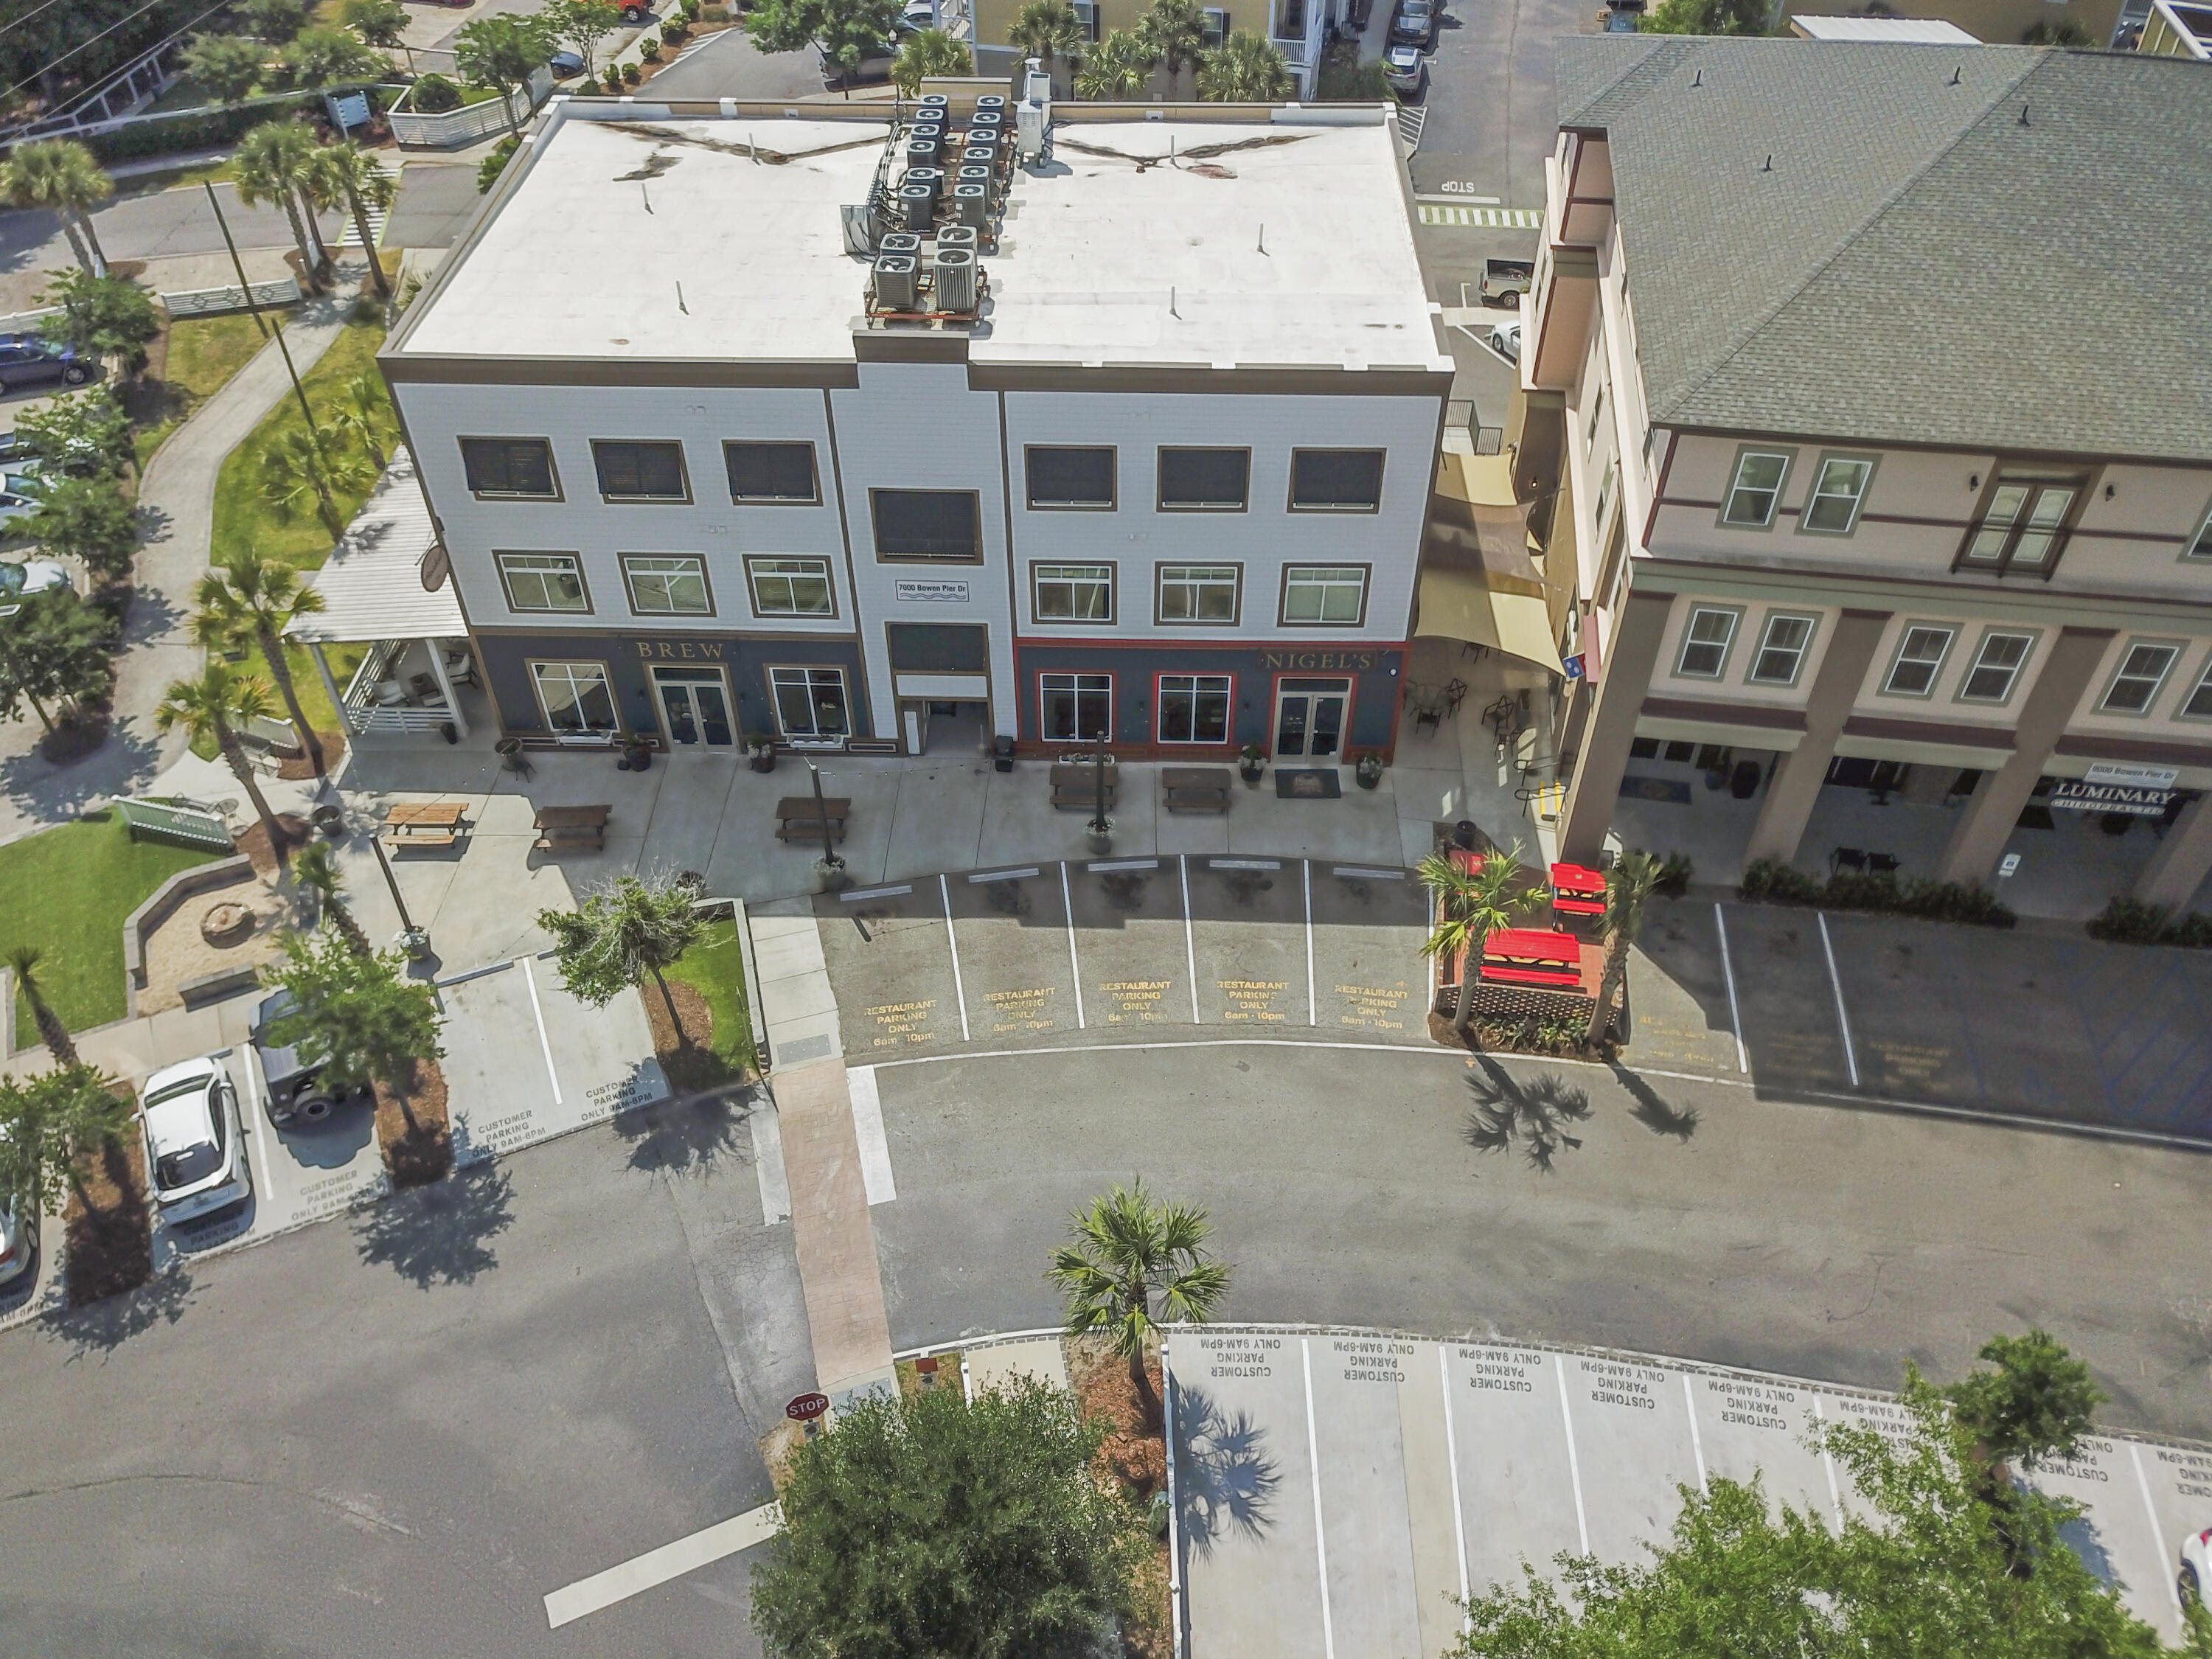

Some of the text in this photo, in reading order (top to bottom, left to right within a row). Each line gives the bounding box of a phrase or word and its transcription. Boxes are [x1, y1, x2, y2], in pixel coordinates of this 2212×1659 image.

[1441, 181, 1475, 192] STOP
[636, 642, 723, 658] BREW
[1266, 653, 1371, 669] NIGEL'S
[2055, 783, 2177, 804] LUMINARY
[1099, 981, 1172, 991] RESTAURANT
[1217, 981, 1290, 990] RESTAURANT
[1335, 984, 1408, 999] RESTAURANT
[984, 987, 1055, 1002] RESTAURANT
[1111, 992, 1161, 1001] PARKING
[863, 1000, 937, 1016] RESTAURANT
[1122, 1002, 1151, 1010] ONLY
[1239, 1001, 1269, 1009] ONLY
[1357, 1007, 1386, 1017] ONLY
[877, 1012, 927, 1024] PARKING
[1225, 1011, 1248, 1019] 6am
[1257, 1012, 1285, 1020] 10pm
[1374, 1018, 1402, 1029] 10pm
[888, 1023, 917, 1033] ONLY
[585, 1075, 639, 1099] CUSTOMER
[594, 1087, 636, 1107] PARKING
[581, 1092, 653, 1121] ONLY 9AM-6PM
[478, 1110, 533, 1134] CUSTOMER
[486, 1121, 529, 1144] PARKING
[473, 1127, 546, 1158] ONLY 9AM-6PM
[300, 1169, 358, 1196] CUSTOMER
[307, 1182, 353, 1205] PARKING
[292, 1207, 318, 1221] ONLY
[1200, 1338, 1281, 1349] ONLY 9AM-6PM
[1333, 1341, 1415, 1355] ONLY 9AM-6PM
[1217, 1352, 1265, 1363] PARKING
[1350, 1356, 1398, 1368] PARKING
[1459, 1348, 1541, 1365] ONLY 9AM-6PM
[1211, 1366, 1272, 1377] CUSTOMER
[1344, 1369, 1405, 1382] CUSTOMER
[1475, 1363, 1525, 1378] PARKING
[1581, 1360, 1665, 1382] ONLY 9AM-6PM
[1470, 1377, 1532, 1393] CUSTOMER
[1598, 1377, 1648, 1394] PARKING
[1708, 1380, 1795, 1403] ONLY 9AM-6PM
[789, 1398, 826, 1416] STOP
[1591, 1390, 1655, 1410] CUSTOMER
[1727, 1397, 1778, 1416] PARKING
[1840, 1400, 1894, 1418] 9AM-6PM
[1722, 1411, 1787, 1430] CUSTOMER
[1859, 1417, 1913, 1435] PARKING
[2037, 1461, 2109, 1482] CUSTOMER
